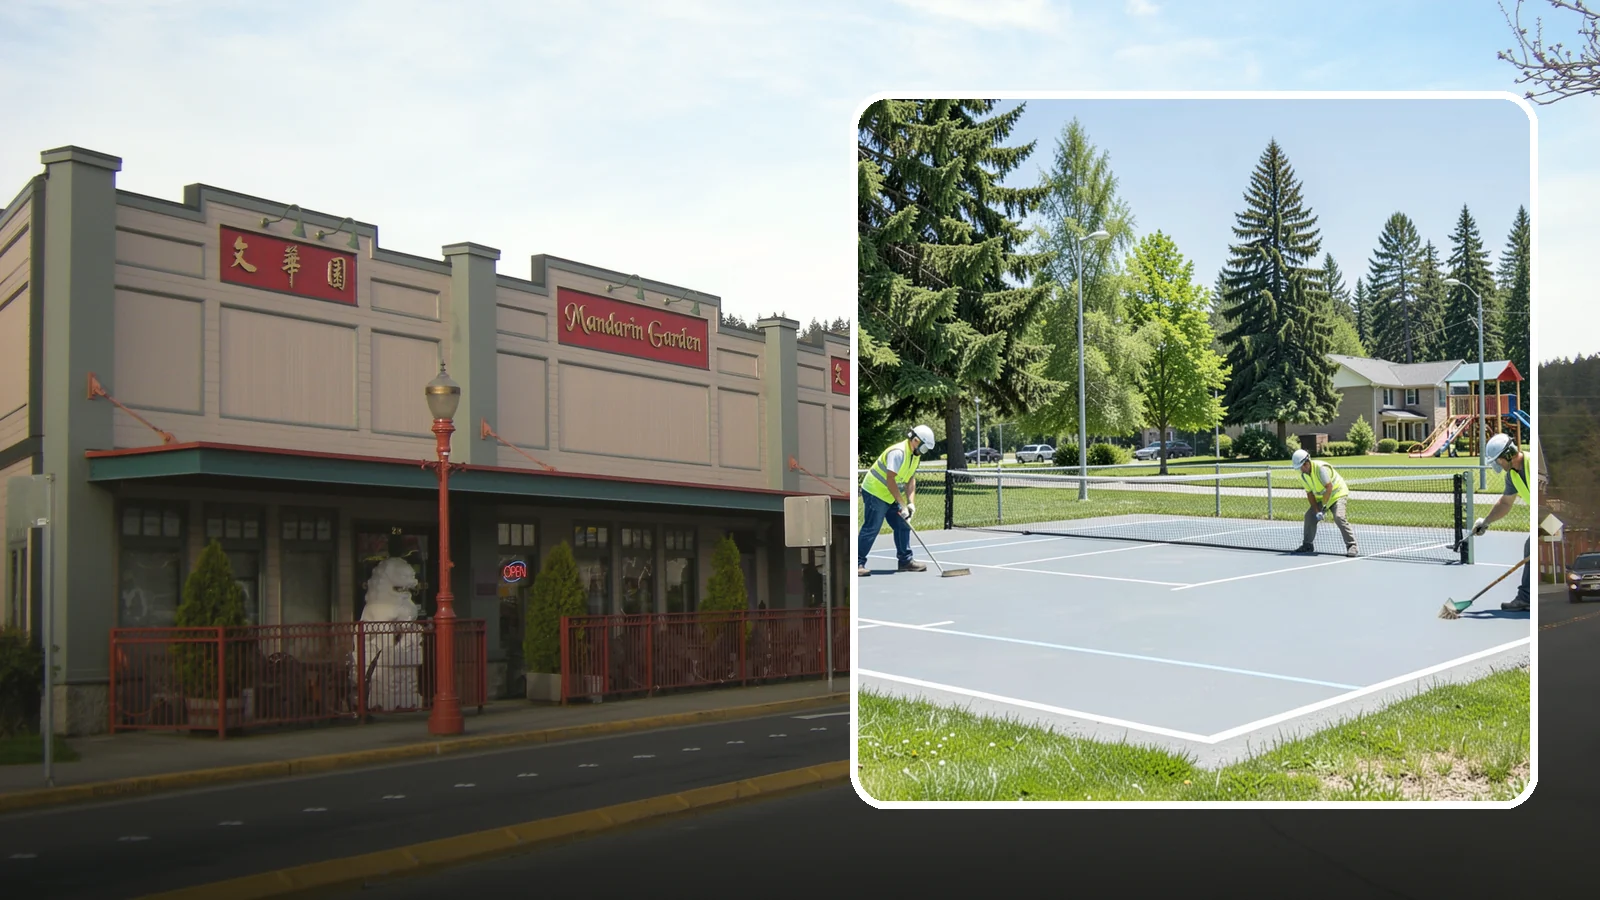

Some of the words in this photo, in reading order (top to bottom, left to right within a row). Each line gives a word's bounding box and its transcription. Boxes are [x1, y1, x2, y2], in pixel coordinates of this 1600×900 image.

[231, 235, 347, 291] 文華園
[564, 302, 644, 341] Mandarin
[647, 320, 701, 352] Garden
[503, 565, 527, 578] OPEN
